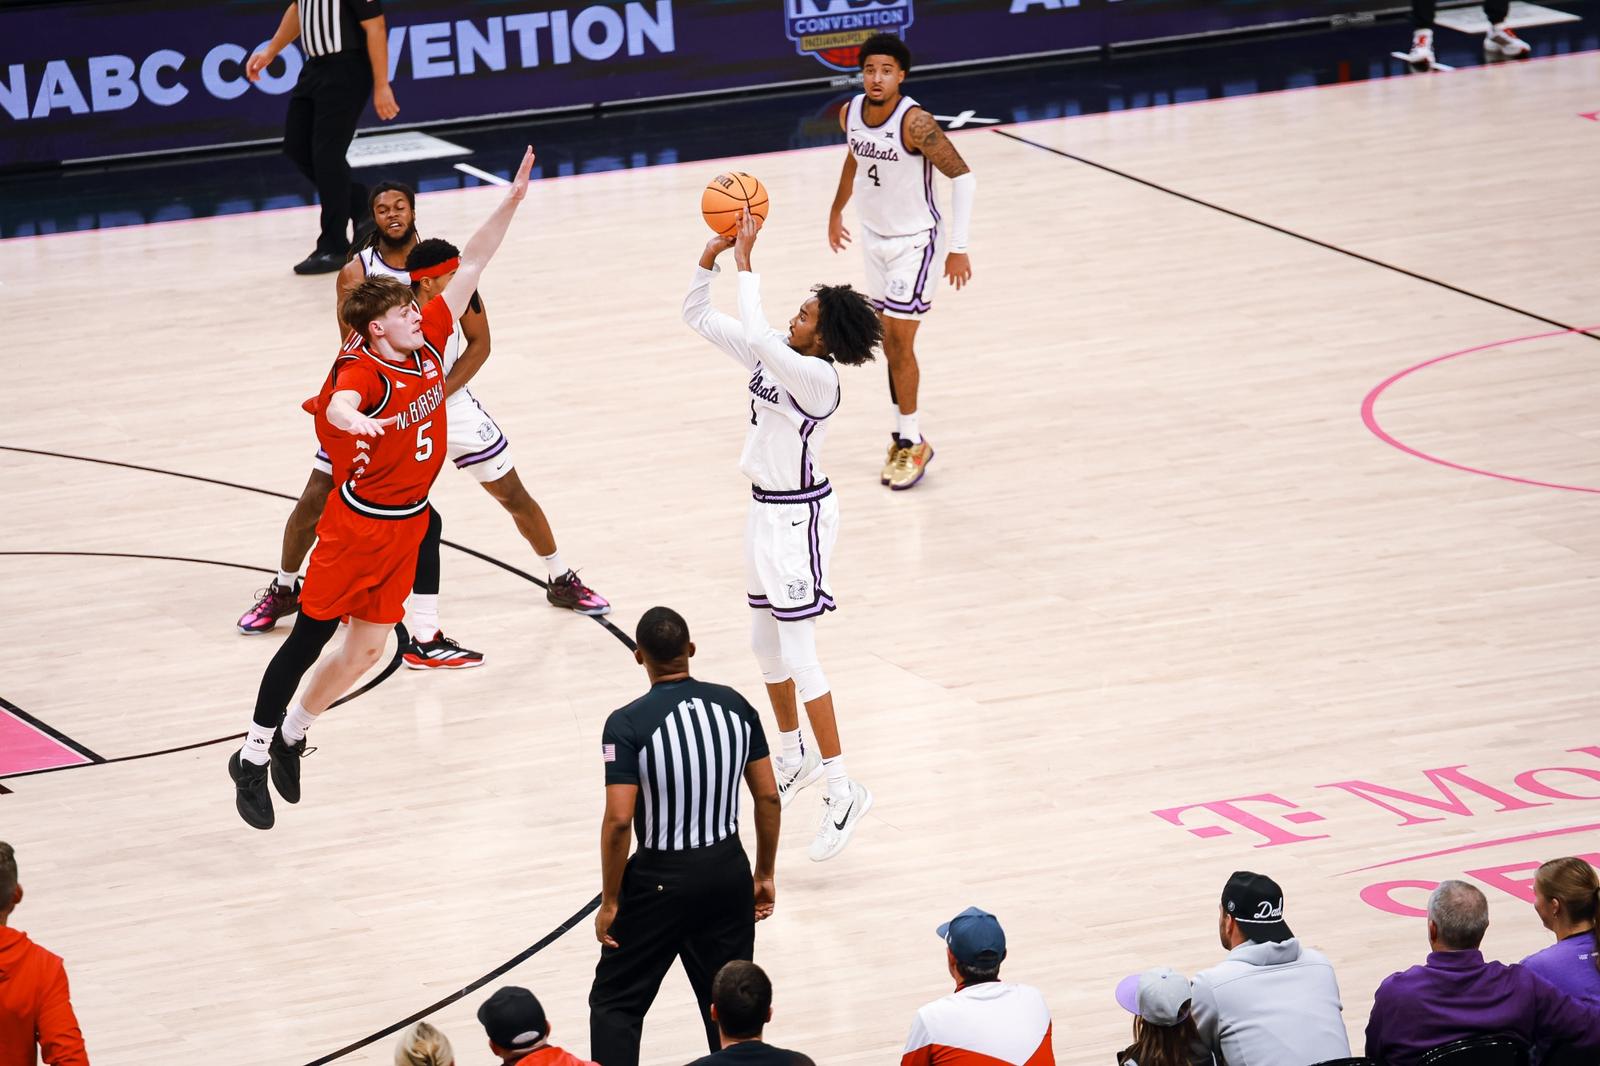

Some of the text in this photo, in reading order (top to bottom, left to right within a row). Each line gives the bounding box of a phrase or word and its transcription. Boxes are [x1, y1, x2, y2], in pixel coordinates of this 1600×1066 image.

[794, 9, 904, 34] CONVENTION
[0, 0, 675, 120] NABC COVENTION
[850, 138, 900, 161] Wildcats
[867, 164, 881, 187] 4
[748, 360, 780, 404] ldcats
[414, 420, 433, 462] 5
